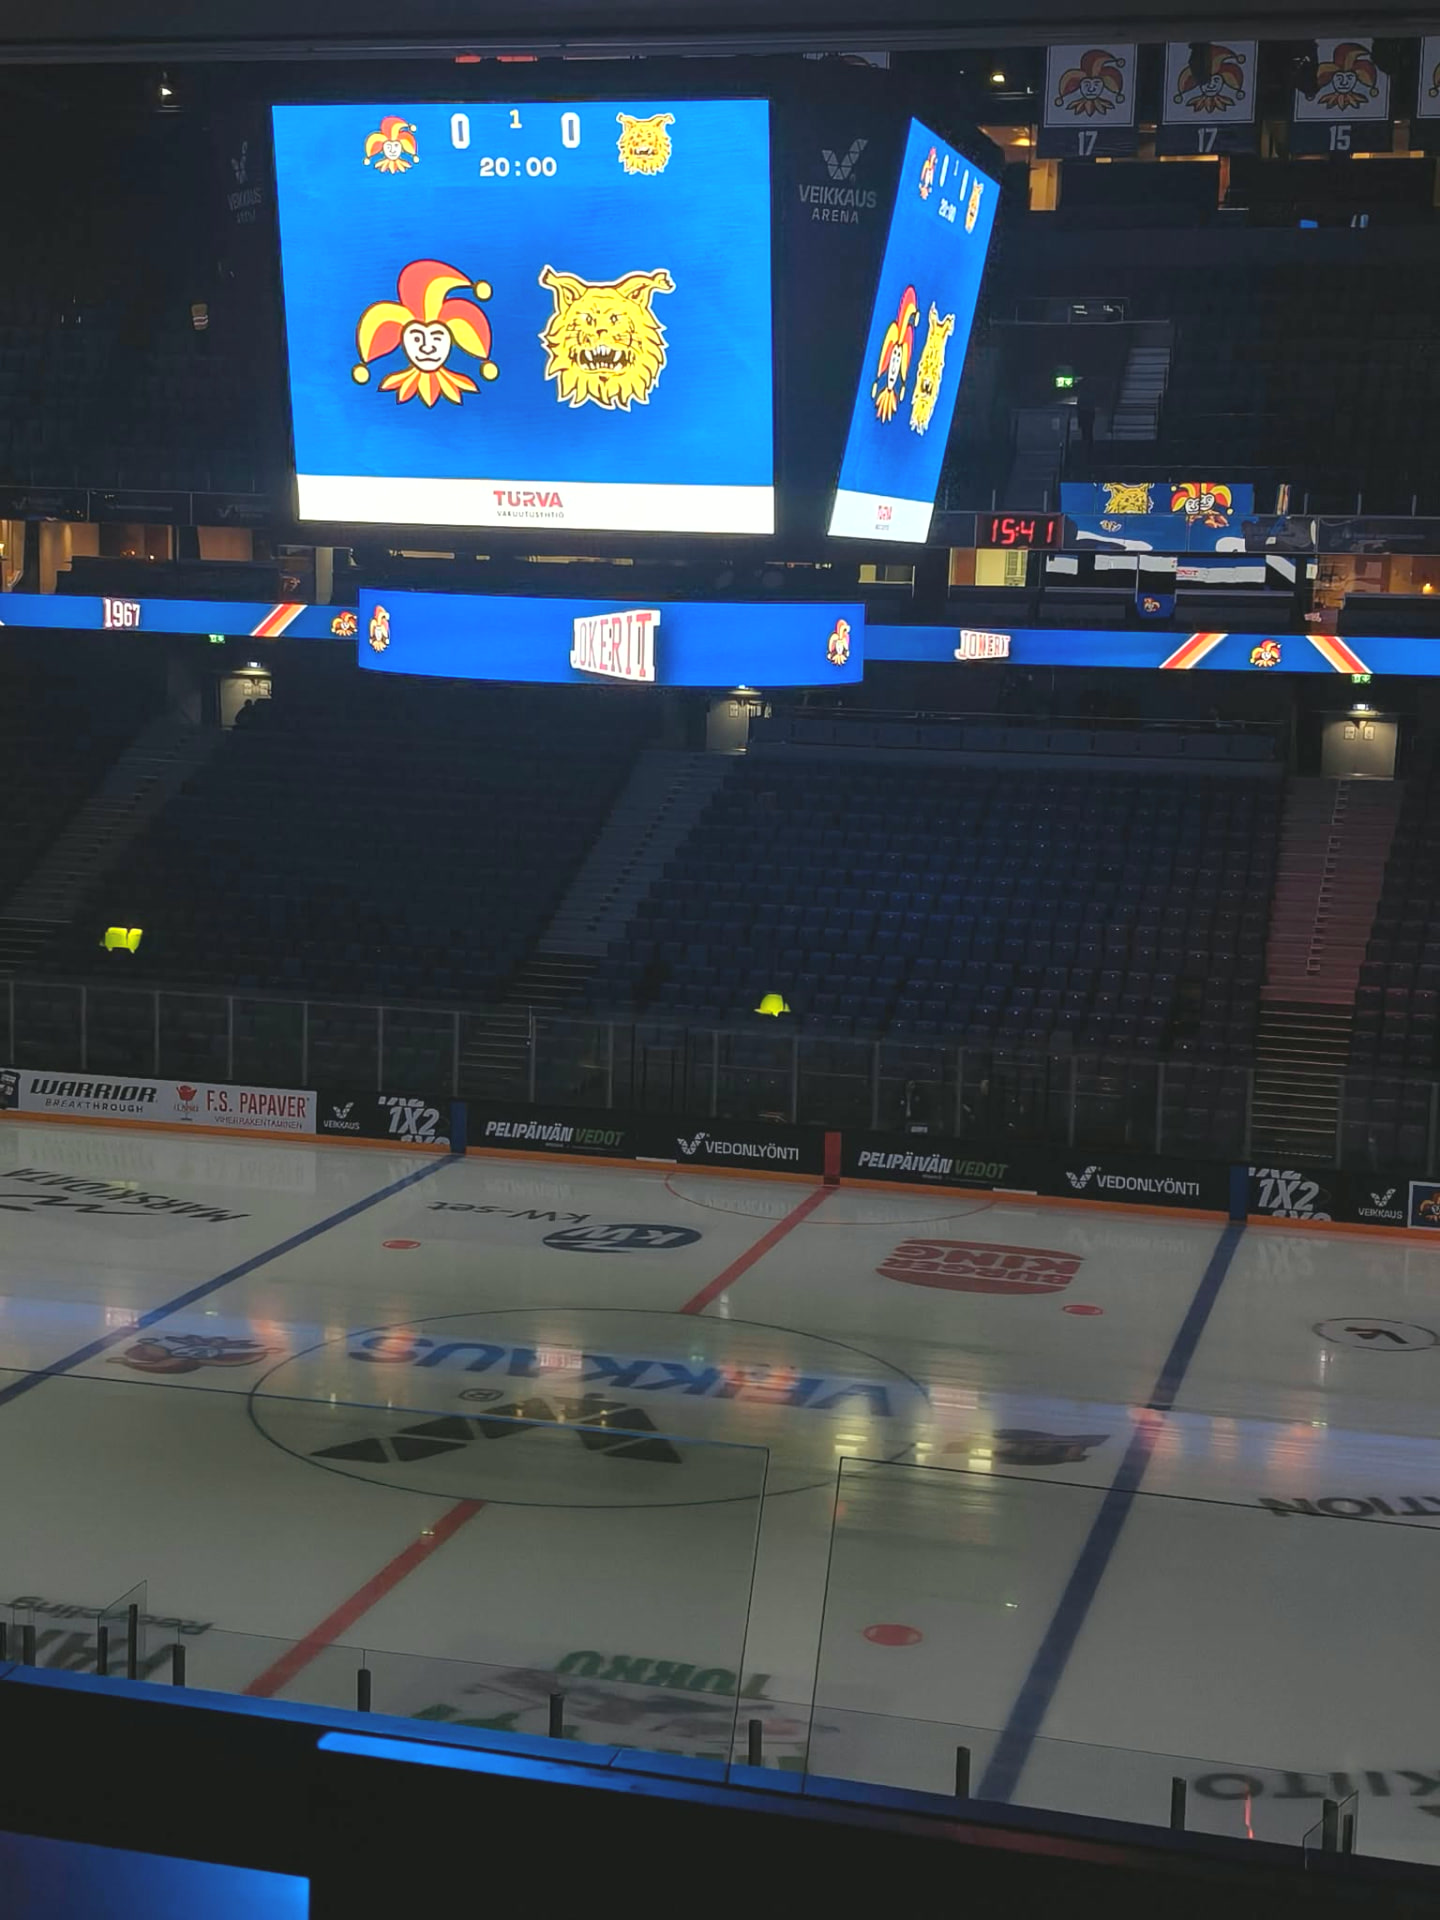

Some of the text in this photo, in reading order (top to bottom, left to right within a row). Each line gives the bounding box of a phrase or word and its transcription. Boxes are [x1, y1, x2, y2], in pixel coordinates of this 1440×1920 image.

[450, 113, 471, 149] 0
[509, 109, 523, 129] 1
[560, 112, 581, 148] 0
[1078, 131, 1098, 156] 17
[1198, 127, 1218, 153] 17
[1329, 125, 1352, 151] 15
[480, 157, 557, 177] 20:00
[799, 183, 878, 209] VEIKKAUS
[811, 207, 860, 225] ARENA
[493, 490, 564, 508] TURVA
[990, 518, 1055, 544] 15:41
[103, 598, 141, 629] 1967
[30, 1078, 158, 1103] WARRIOR
[207, 1089, 307, 1118] F.S. PAPAVER
[45, 1098, 144, 1113] BREAKTHROUGH
[388, 1106, 440, 1136] 1X2
[484, 1121, 625, 1147] PELIPÄIVÄN VEDOT
[705, 1140, 800, 1161] VEDONLYÖNTI
[857, 1150, 1010, 1180] PELIPÄIVÄN VEDOT
[1096, 1173, 1201, 1196] VEDONLYÖNTI
[1258, 1178, 1320, 1211] 1X2
[1357, 1207, 1404, 1220] VEIKKAUS
[882, 1257, 1074, 1285] BURGER
[893, 1245, 1083, 1276] KING
